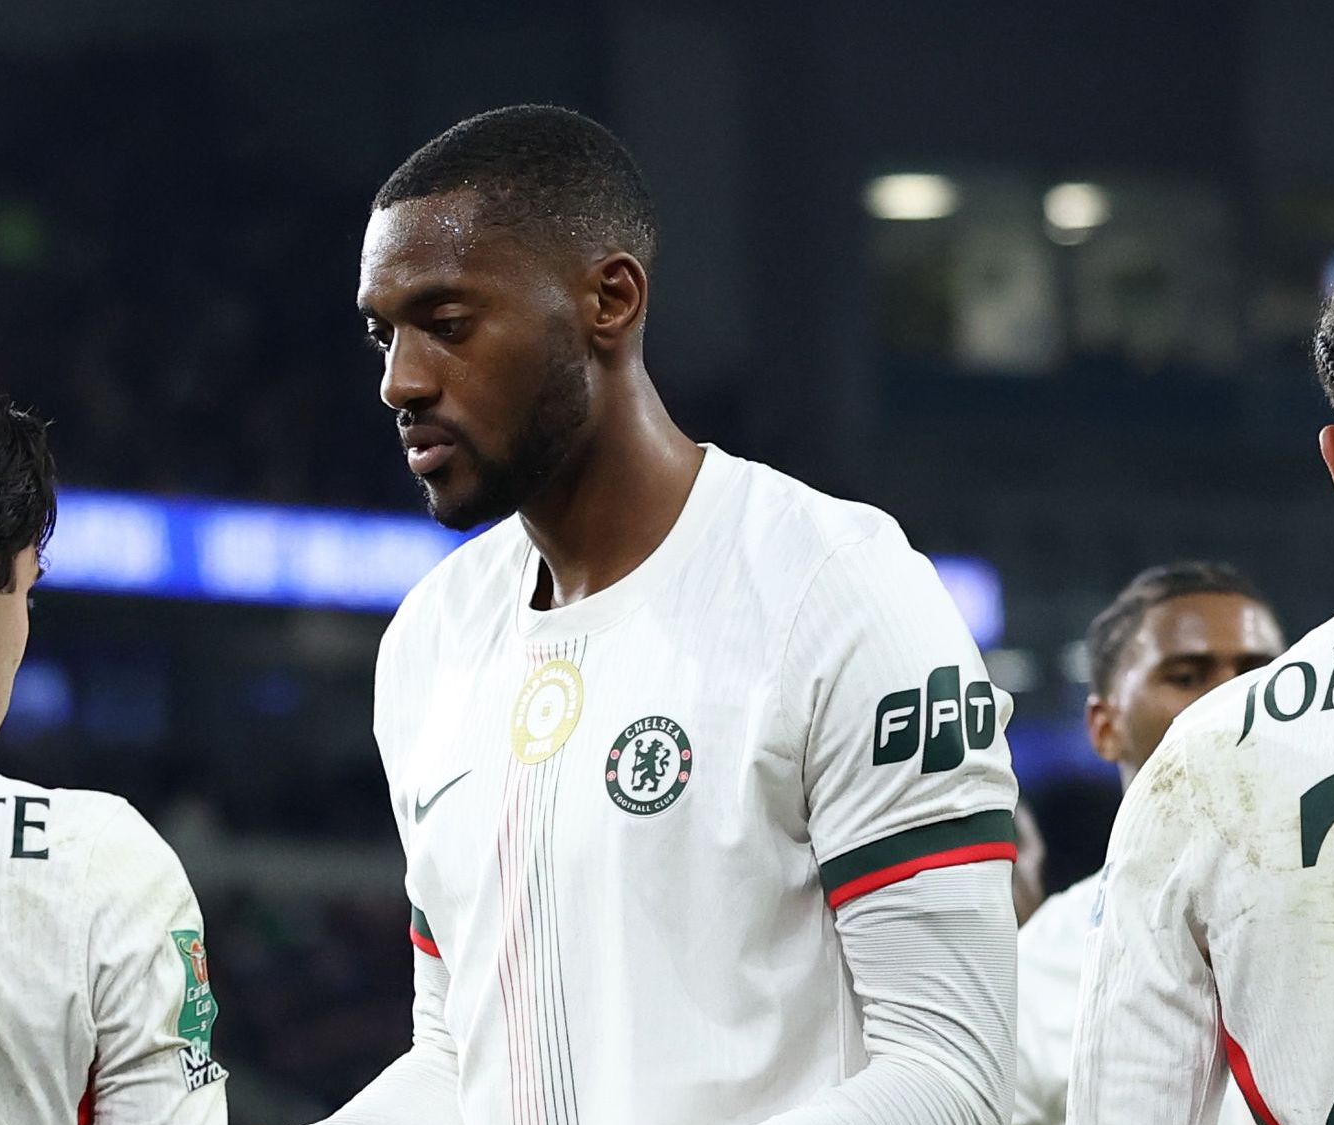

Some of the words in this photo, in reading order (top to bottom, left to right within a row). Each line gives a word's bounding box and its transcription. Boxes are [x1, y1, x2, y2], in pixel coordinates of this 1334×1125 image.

[625, 718, 681, 740] CHELSEA
[613, 793, 651, 812] FOOTBALL
[654, 793, 675, 809] CLUB
[179, 1046, 206, 1069] No
[186, 1067, 207, 1092] for
